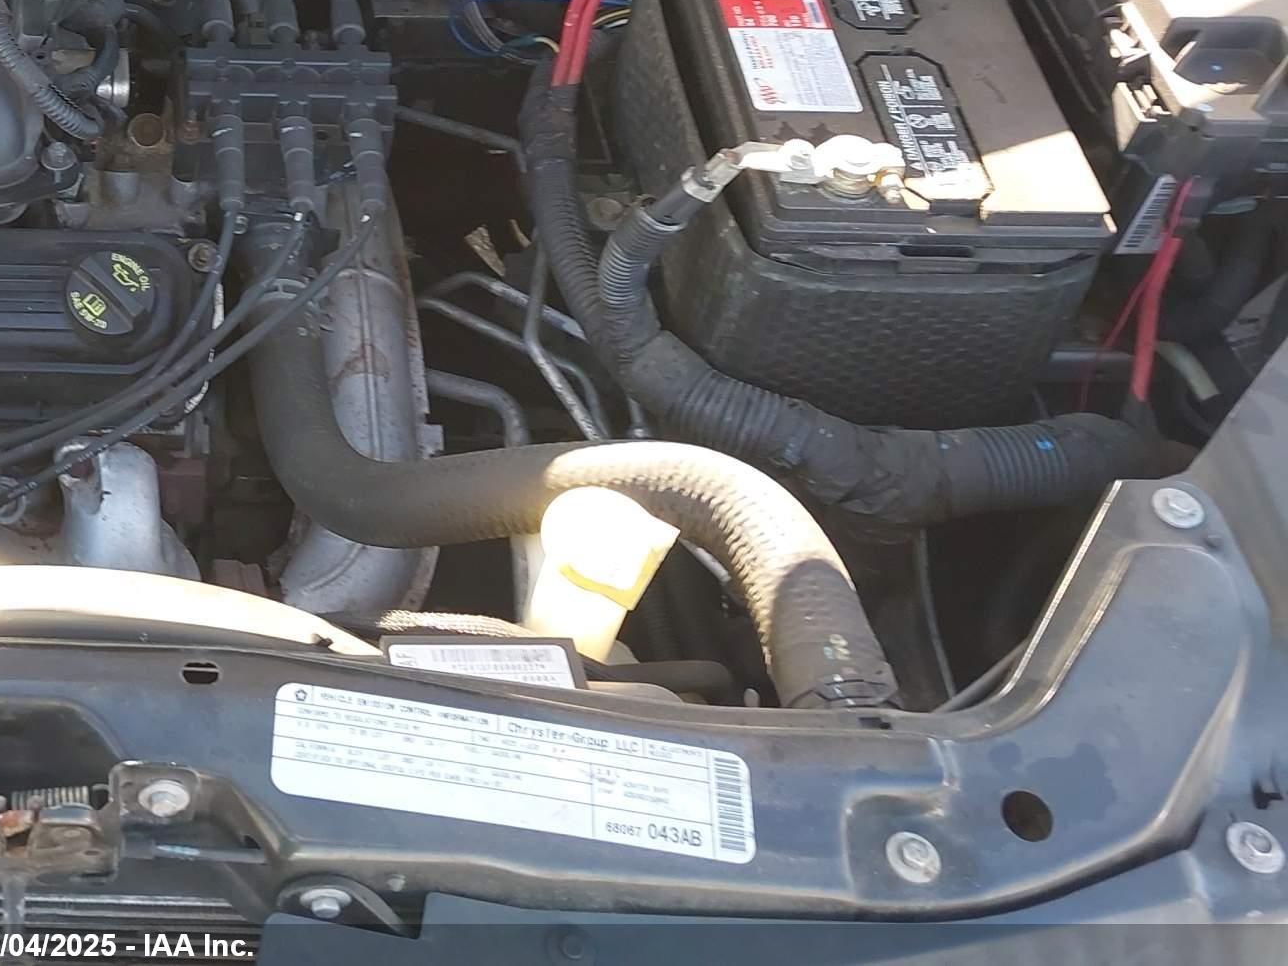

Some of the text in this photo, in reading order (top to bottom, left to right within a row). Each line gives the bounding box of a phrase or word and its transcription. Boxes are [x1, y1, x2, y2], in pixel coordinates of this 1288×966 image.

[111, 252, 151, 292] ENGINE OIL
[507, 721, 565, 739] Chrysler
[572, 732, 609, 751] Group
[615, 738, 639, 754] LLC
[647, 823, 703, 848] 043AB
